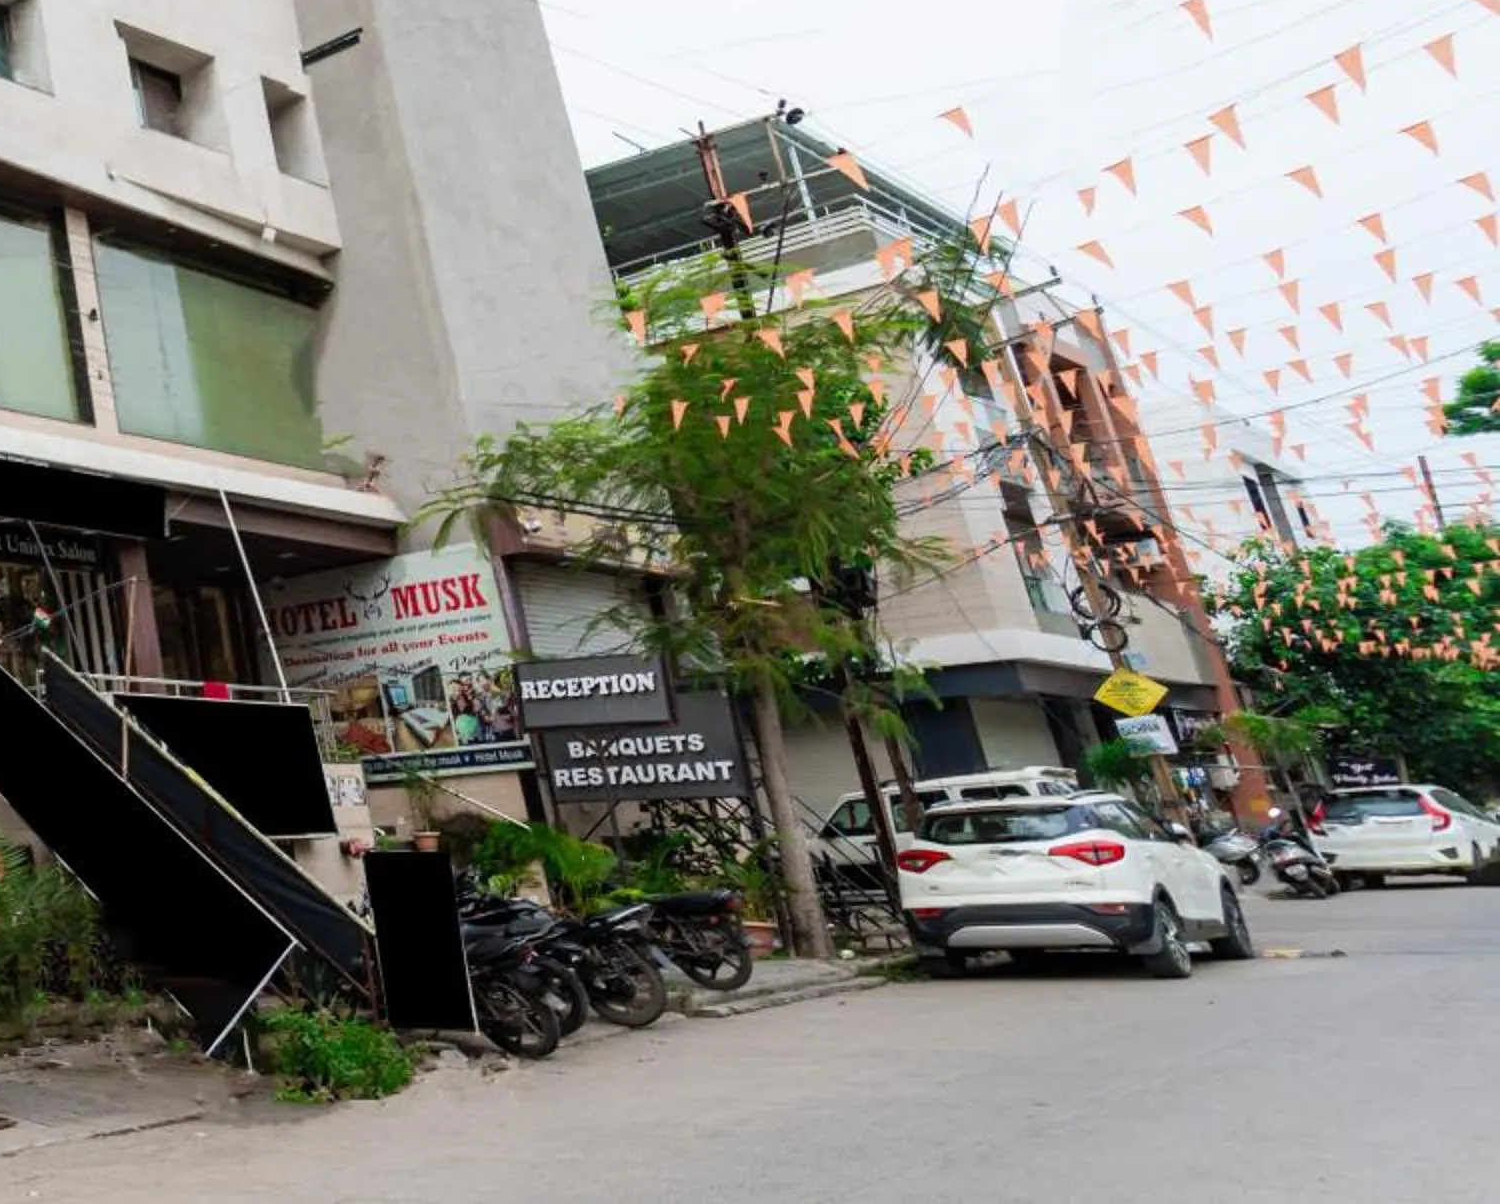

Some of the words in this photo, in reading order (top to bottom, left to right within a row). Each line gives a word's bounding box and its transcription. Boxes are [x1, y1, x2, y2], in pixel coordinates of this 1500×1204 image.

[7, 534, 54, 558] Unisx
[390, 573, 487, 620] MUSK
[381, 641, 399, 654] all
[438, 630, 490, 645] Events
[520, 671, 655, 699] RECEPTION
[554, 761, 734, 788] RESTAURANT
